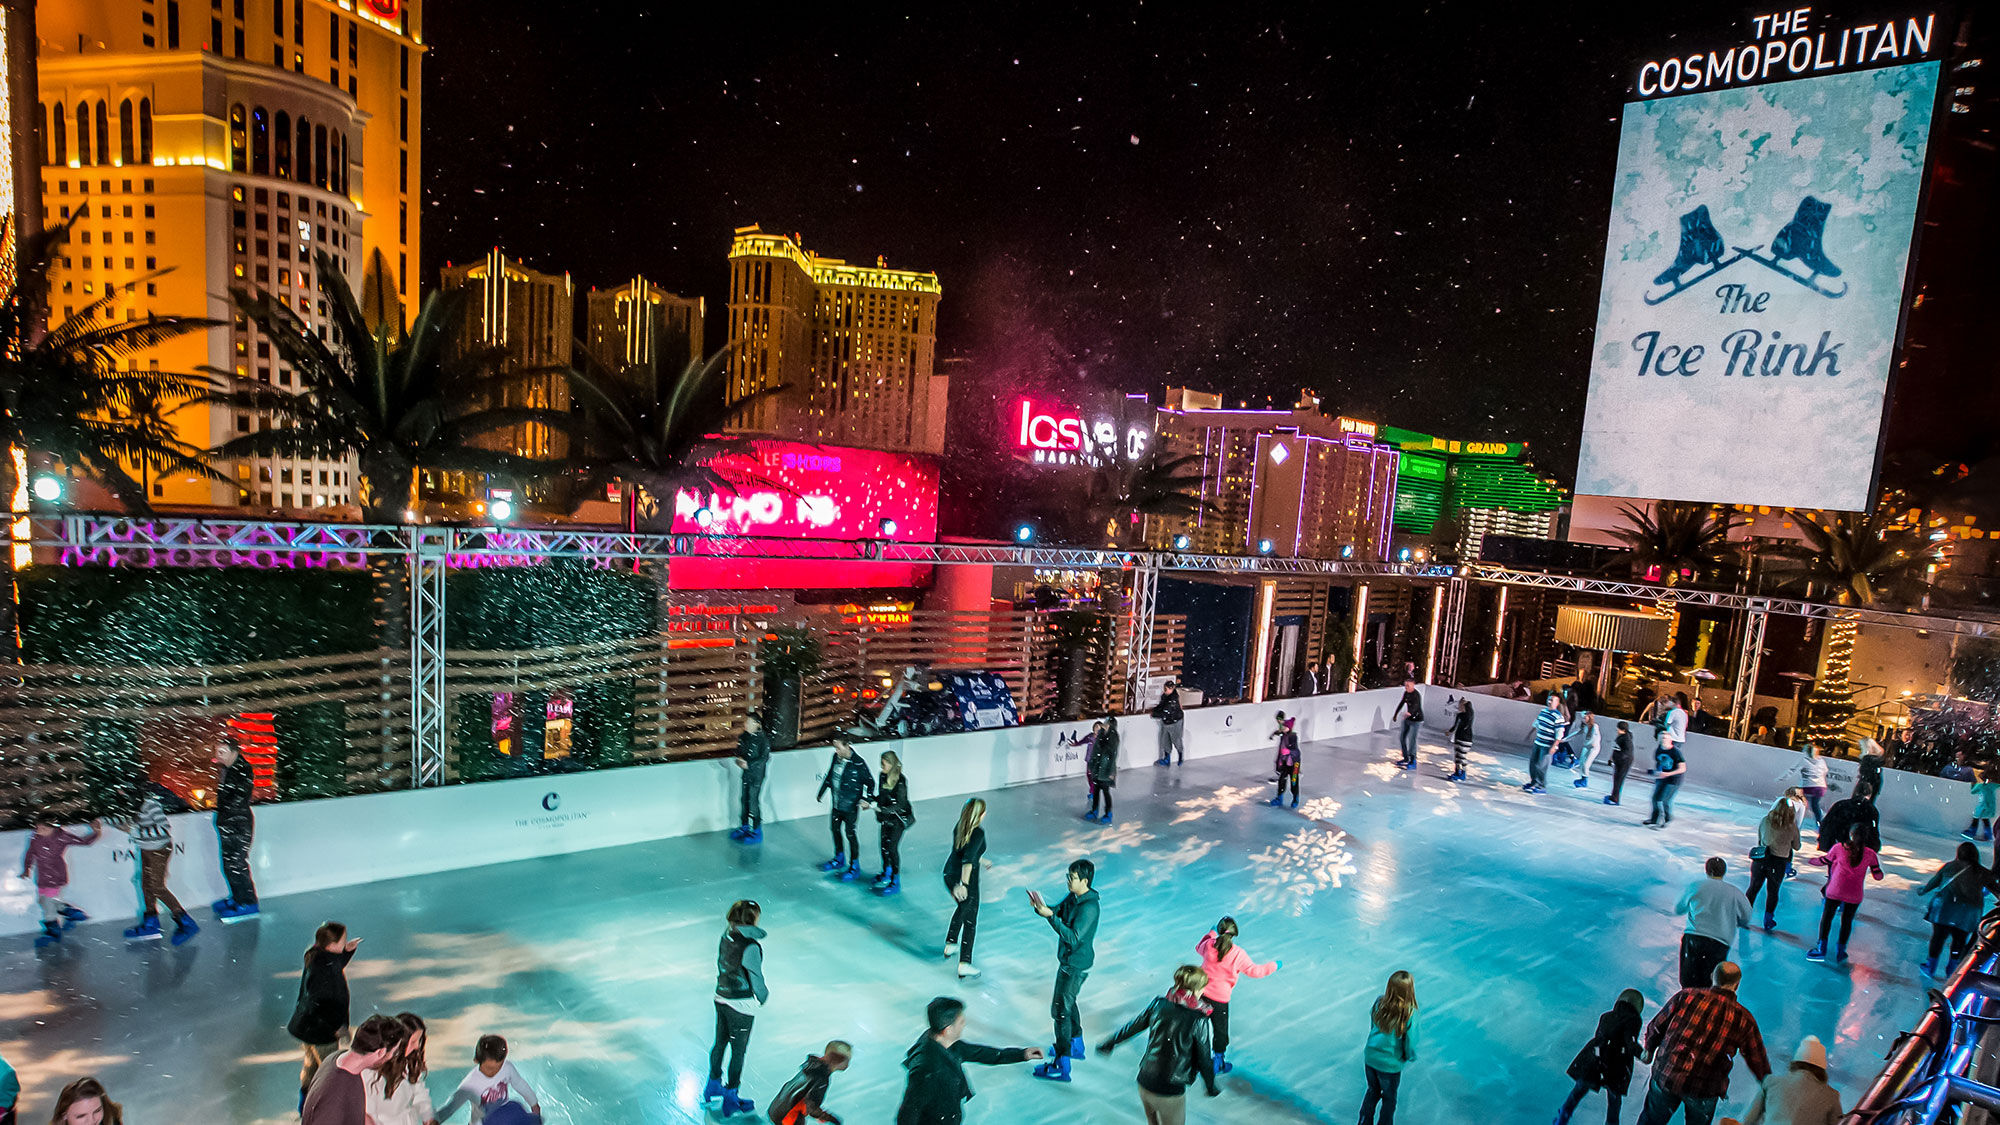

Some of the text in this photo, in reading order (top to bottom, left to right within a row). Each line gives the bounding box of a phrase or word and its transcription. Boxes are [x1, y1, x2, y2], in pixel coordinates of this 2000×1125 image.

[1753, 7, 1812, 39] THE
[1638, 14, 1936, 96] COSMOPOLITAN
[1715, 283, 1771, 314] The
[1631, 328, 1845, 377] Ice Rink
[782, 453, 841, 473] SHOPS
[1467, 442, 1508, 454] GRAND
[515, 819, 528, 828] THE
[530, 811, 588, 826] COSMOPOLITAN
